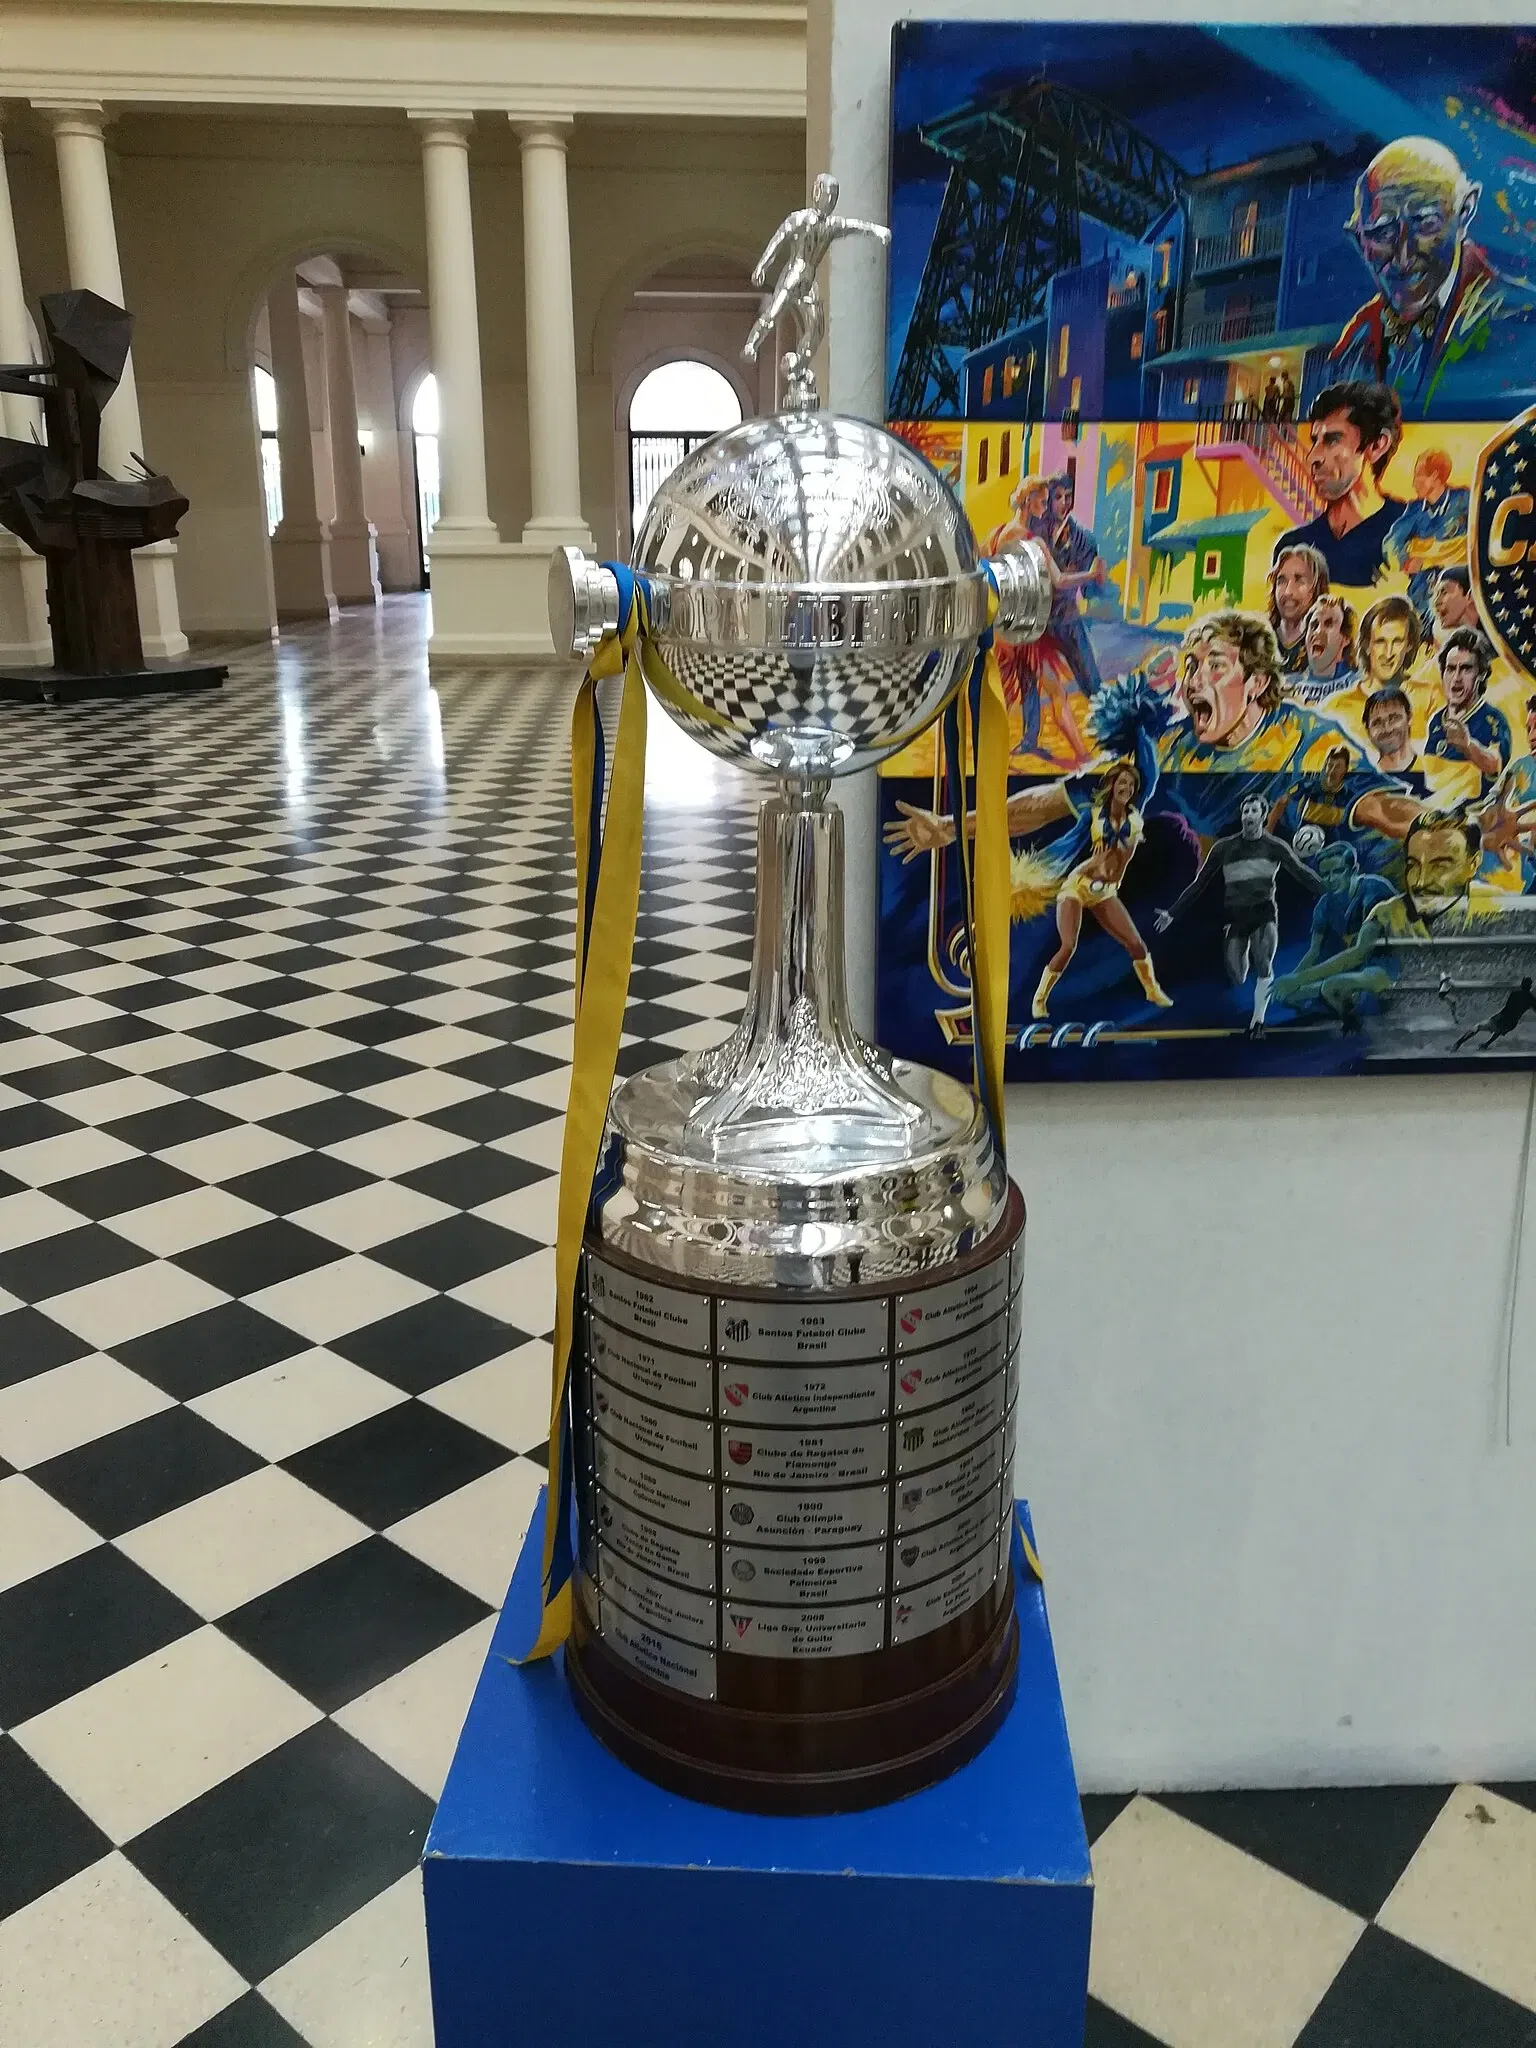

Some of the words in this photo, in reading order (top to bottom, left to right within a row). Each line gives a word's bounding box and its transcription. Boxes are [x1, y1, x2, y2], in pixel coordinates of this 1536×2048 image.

[1489, 492, 1536, 567] C
[758, 1328, 792, 1337] Santos
[796, 1329, 834, 1338] Futebol
[838, 1327, 866, 1336] Clube
[797, 1342, 827, 1350] Brasil
[752, 1392, 772, 1401] Club
[813, 1390, 875, 1402] Independiente
[792, 1405, 836, 1414] Argentina
[757, 1449, 786, 1457] Clube
[806, 1448, 848, 1458] Regatas
[785, 1460, 837, 1469] Flamengo
[754, 1469, 770, 1477] Rio
[790, 1471, 828, 1479] Janeiro
[838, 1467, 867, 1477] Brasil
[776, 1514, 800, 1522] Club
[803, 1514, 843, 1523] Olimpia
[814, 1524, 862, 1534] Paraguay
[764, 1567, 815, 1576] Sociedade
[818, 1566, 863, 1575] Esportiva
[789, 1579, 837, 1587] Palmeiras
[799, 1589, 827, 1597] Brasil
[758, 1623, 778, 1632] Liga
